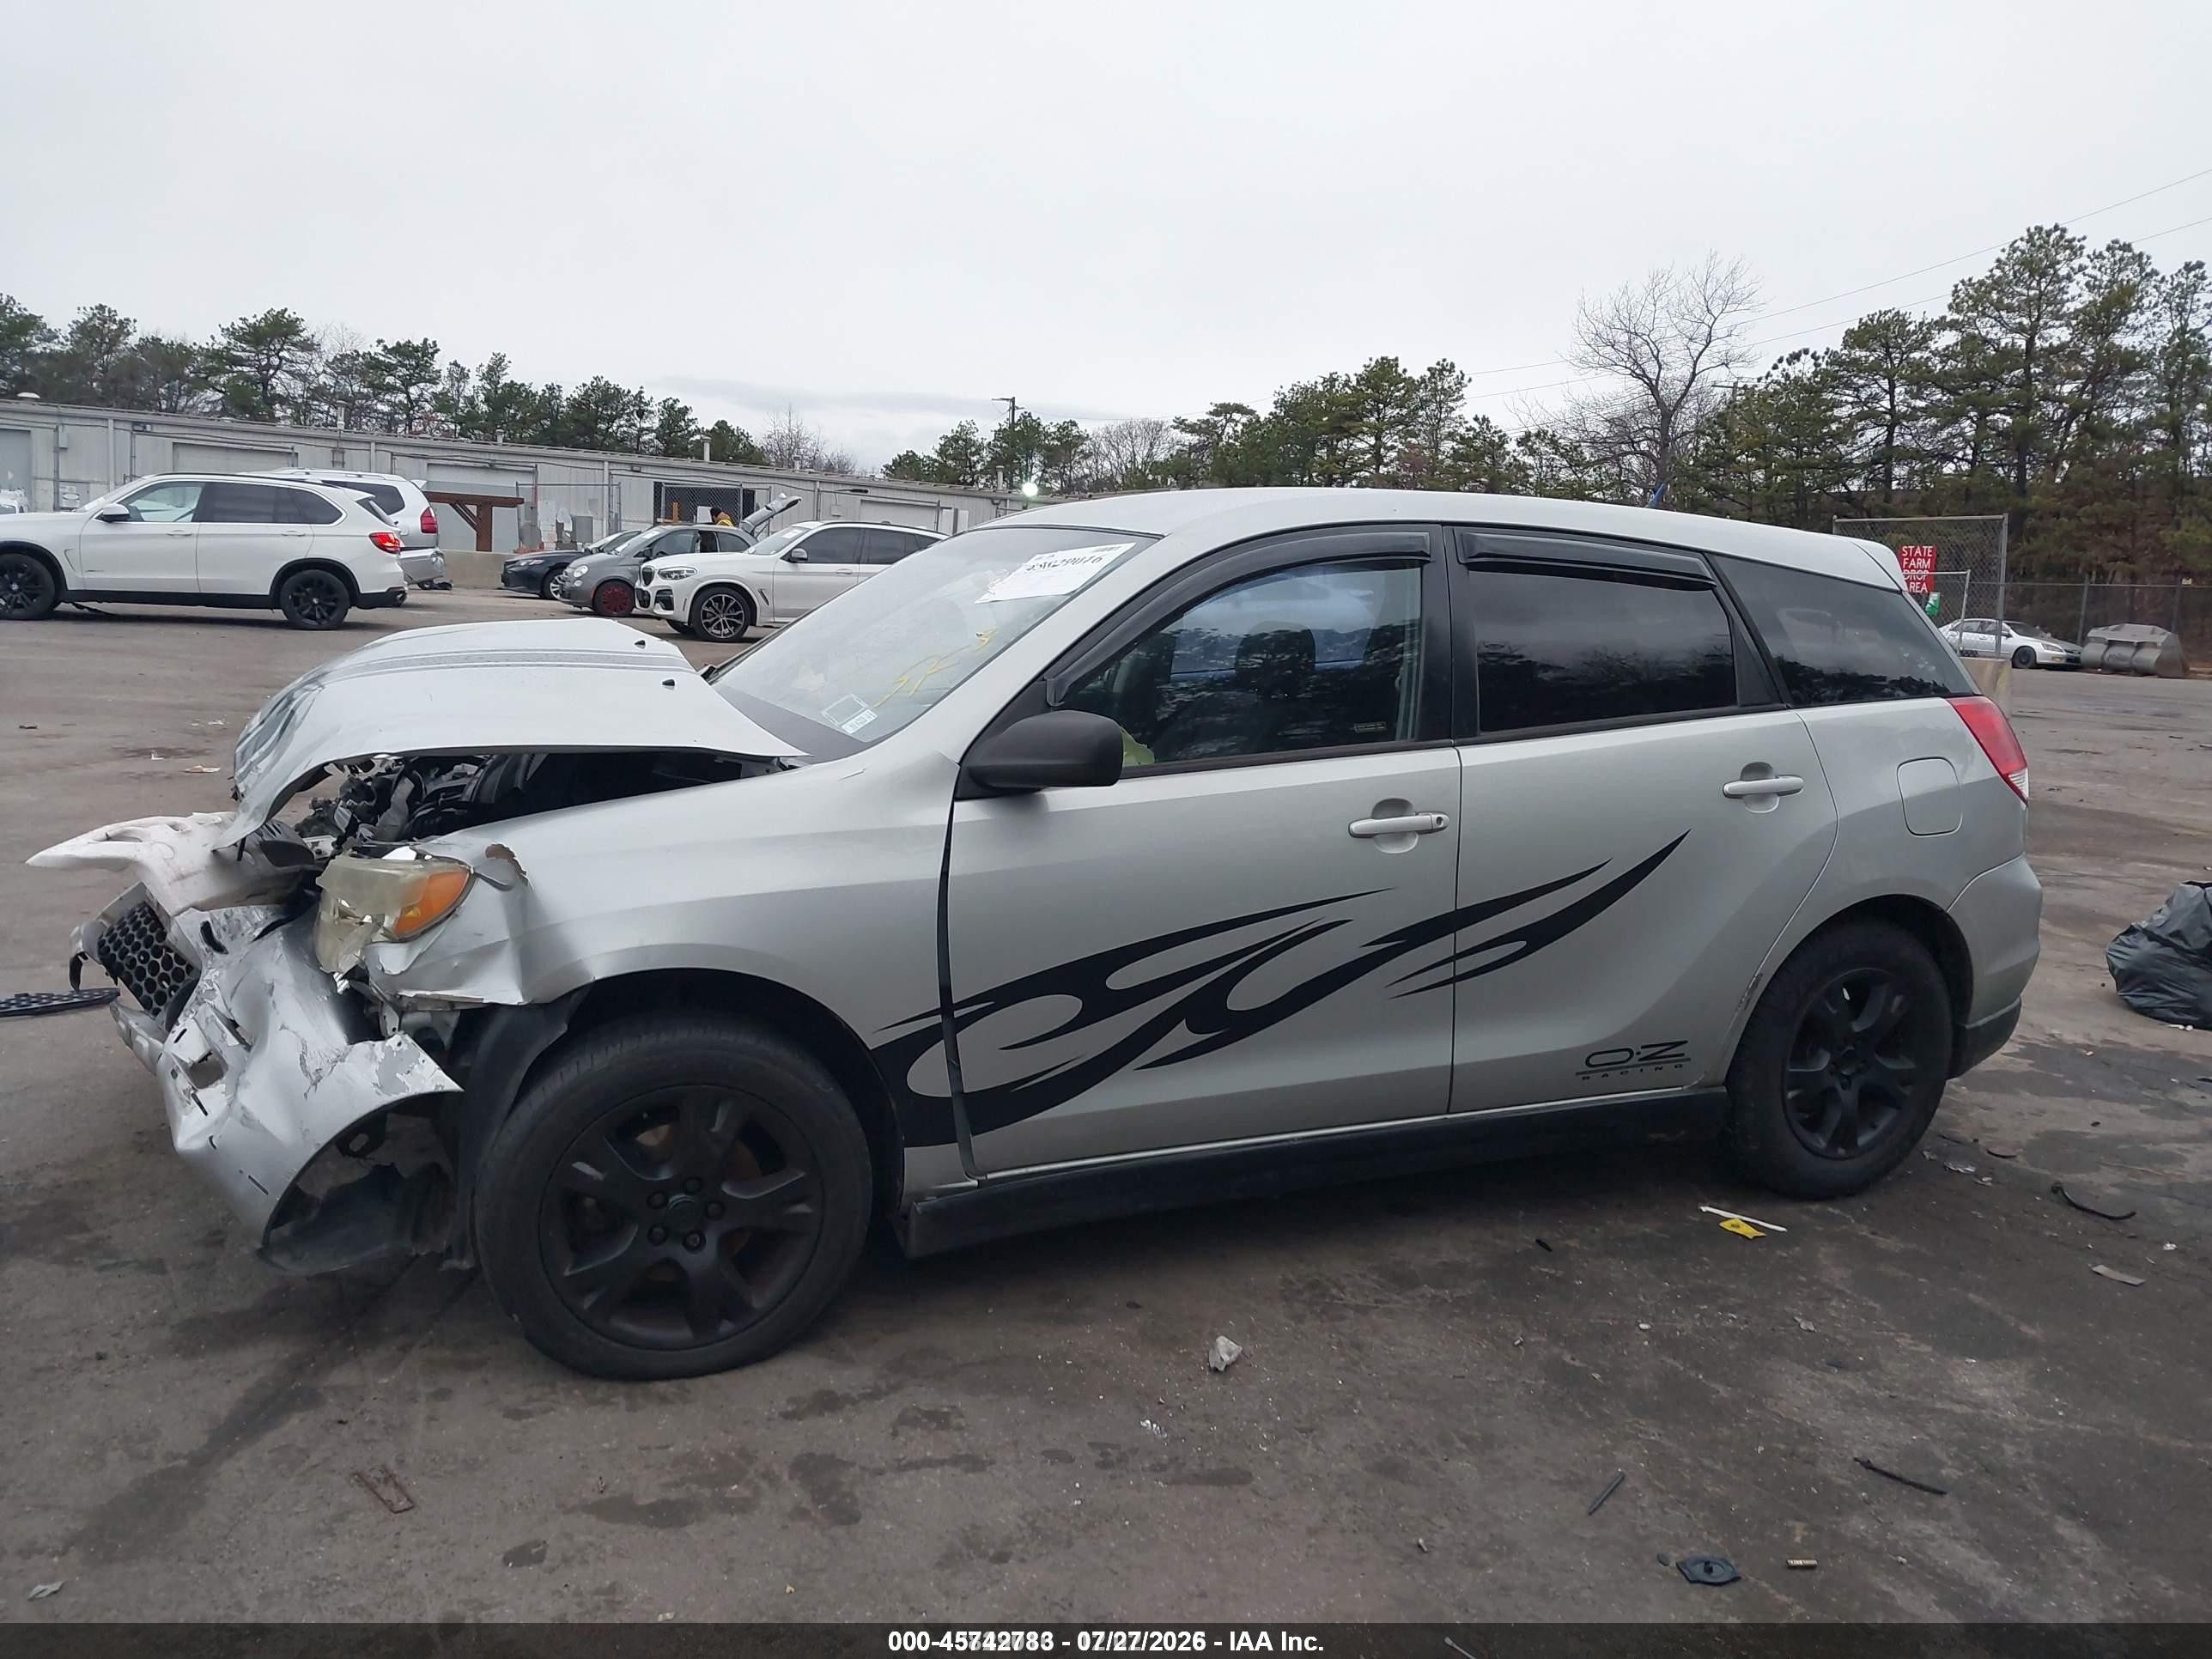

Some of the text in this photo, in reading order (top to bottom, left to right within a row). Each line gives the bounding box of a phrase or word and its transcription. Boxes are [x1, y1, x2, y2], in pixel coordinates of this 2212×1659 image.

[1902, 545, 1933, 557] STATE
[1902, 558, 1931, 569] FARM
[1903, 569, 1930, 580] DROP
[1907, 581, 1928, 592] REA
[1582, 1063, 1683, 1080] RACING
